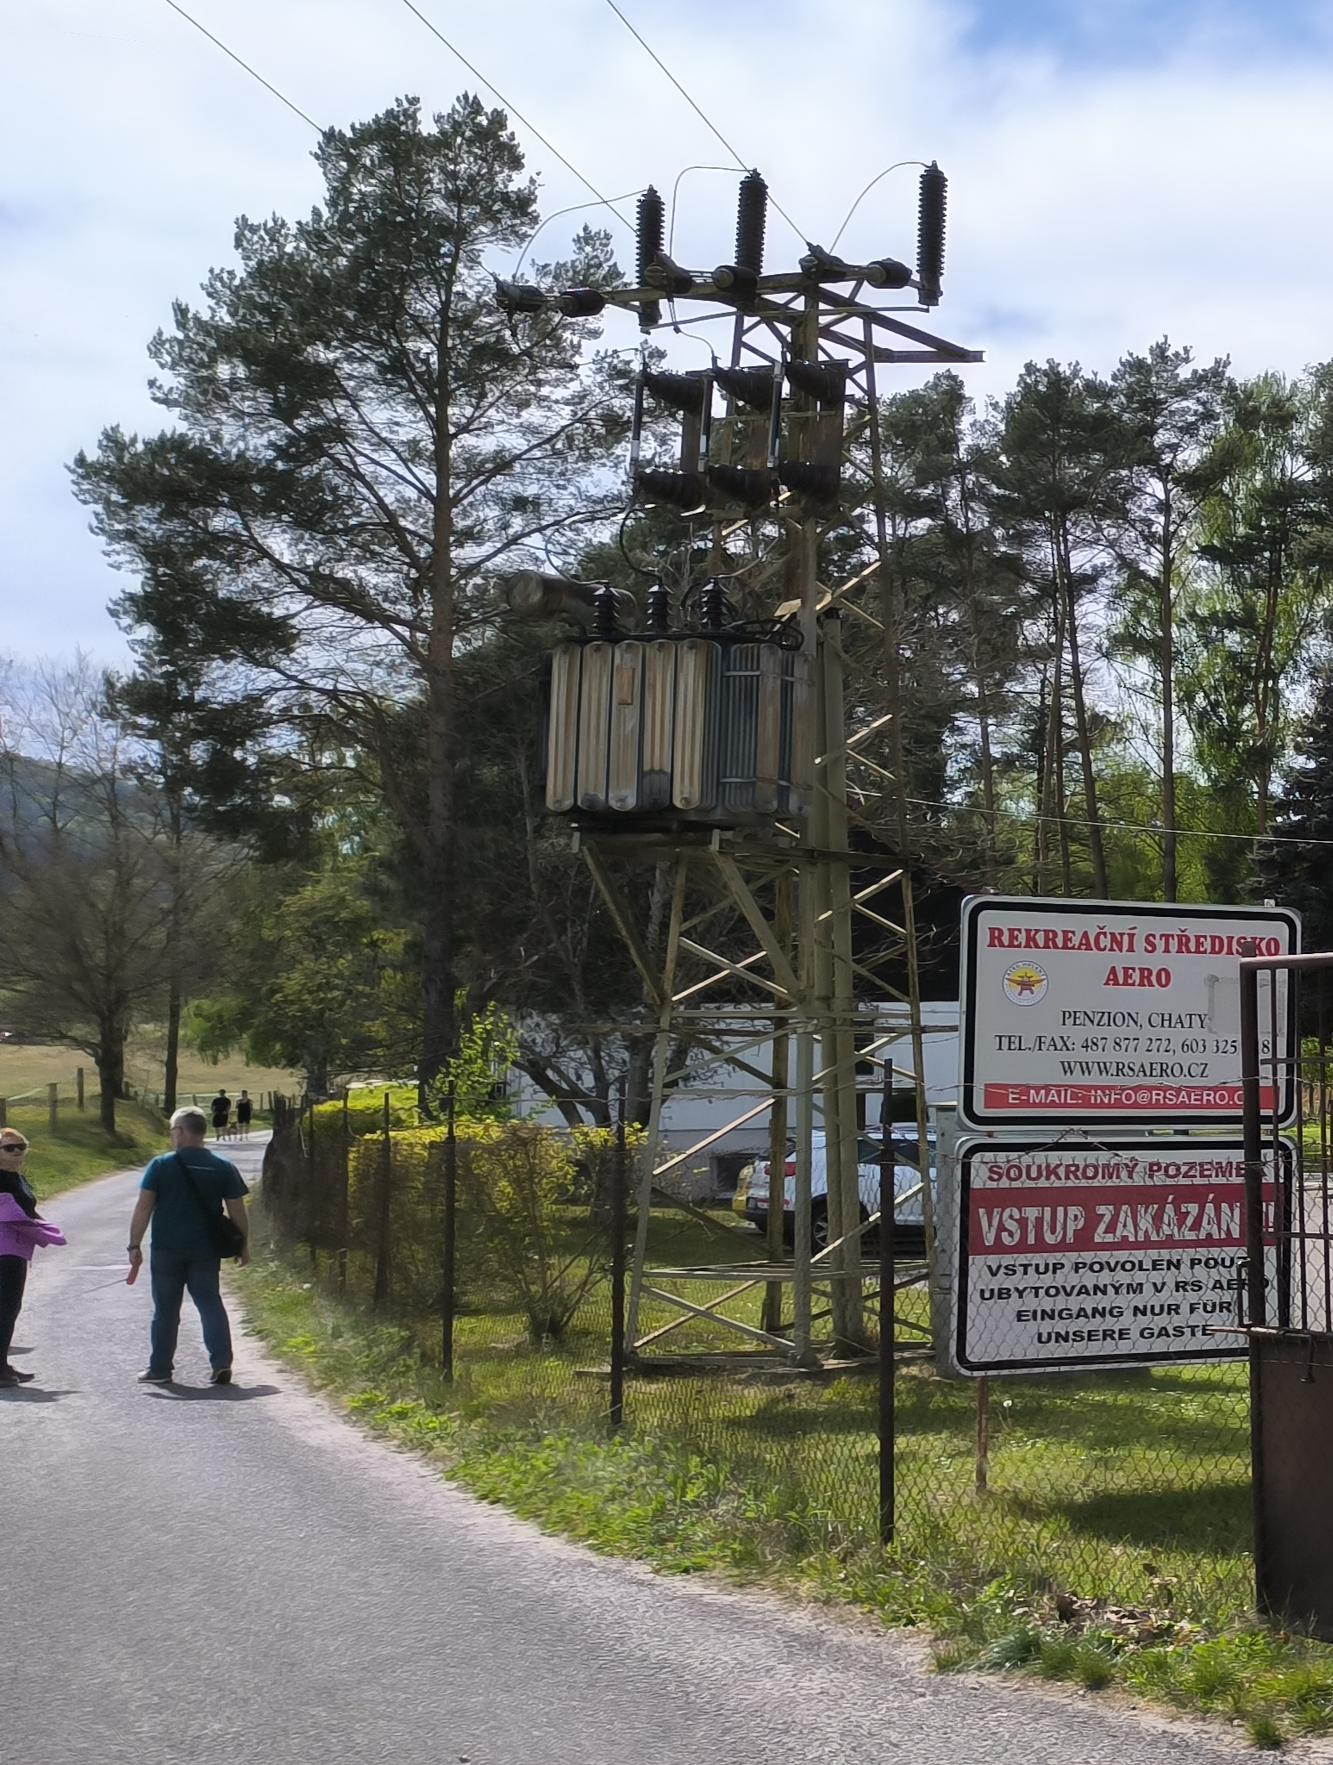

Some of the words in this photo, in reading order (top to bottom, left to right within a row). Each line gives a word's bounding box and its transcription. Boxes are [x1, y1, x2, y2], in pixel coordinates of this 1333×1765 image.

[987, 925, 1137, 953] REKREAČNÍ
[1103, 966, 1172, 989] AERO
[1061, 1010, 1143, 1030] PENZION,
[1148, 1012, 1208, 1029] CHATY
[994, 1035, 1076, 1052] TEL./FAX:
[1081, 1037, 1107, 1053] 487
[1113, 1037, 1140, 1053] 877
[1146, 1038, 1176, 1055] 272,
[1181, 1038, 1207, 1054] 603
[1212, 1038, 1238, 1055] 325
[1059, 1061, 1209, 1079] WWW.RSAERO.CZ
[1008, 1088, 1083, 1103] E-MAIL:
[1090, 1089, 1245, 1105] INFO@RSAERO.C
[988, 1156, 1138, 1182] SOUKROMÝ
[978, 1206, 1085, 1246] VSTUP
[1095, 1194, 1240, 1243] ZAKÁZÁN
[986, 1262, 1063, 1277] VSTUP
[1074, 1258, 1181, 1274] POVOLEN
[980, 1279, 1144, 1301] UBYTOVANÝM
[1152, 1282, 1166, 1294] V
[1174, 1280, 1203, 1294] RS
[1015, 1306, 1124, 1323] EINGANG
[1133, 1303, 1181, 1318] NUR
[1190, 1299, 1232, 1315] FÜR
[1037, 1329, 1130, 1345] UNSERE
